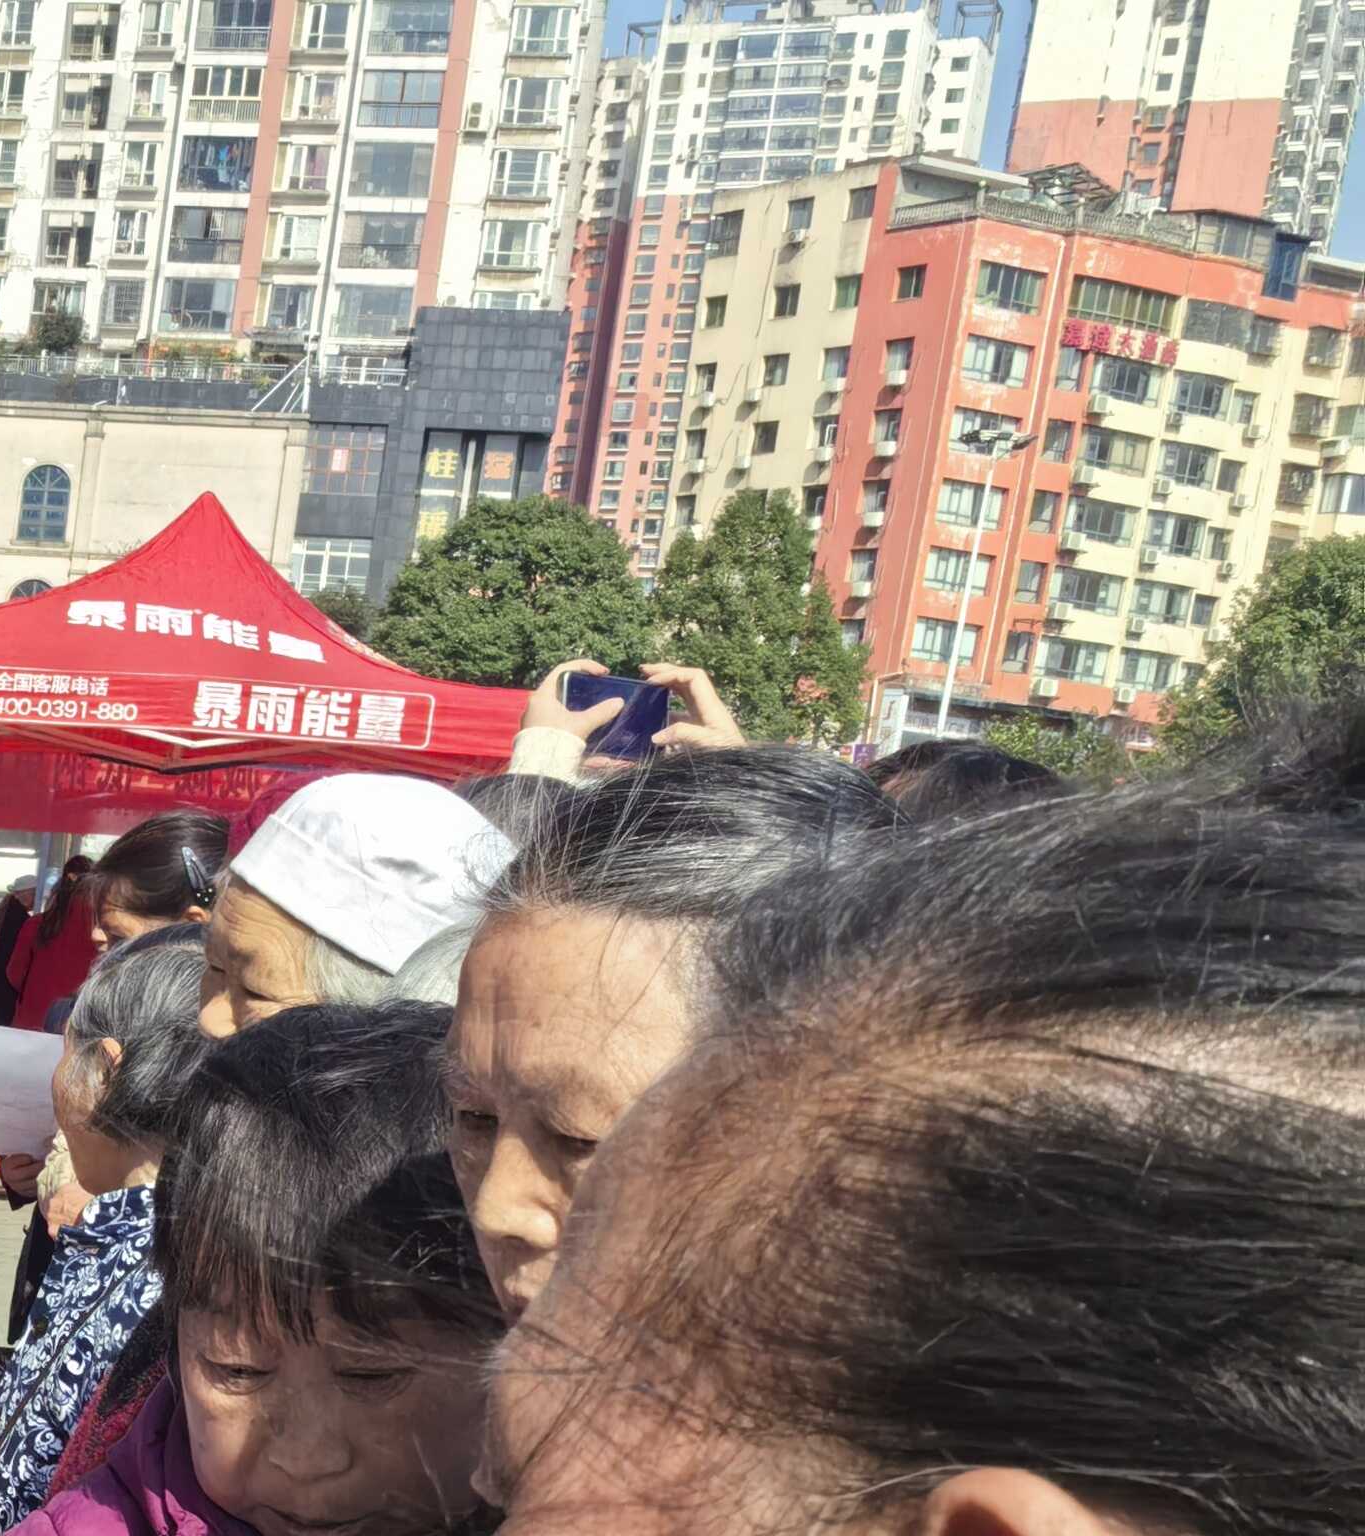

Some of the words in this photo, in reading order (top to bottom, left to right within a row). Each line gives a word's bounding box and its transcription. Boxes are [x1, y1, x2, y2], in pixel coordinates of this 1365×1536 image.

[66, 600, 327, 664] 暴雨能量
[192, 680, 406, 744] 暴雨能量
